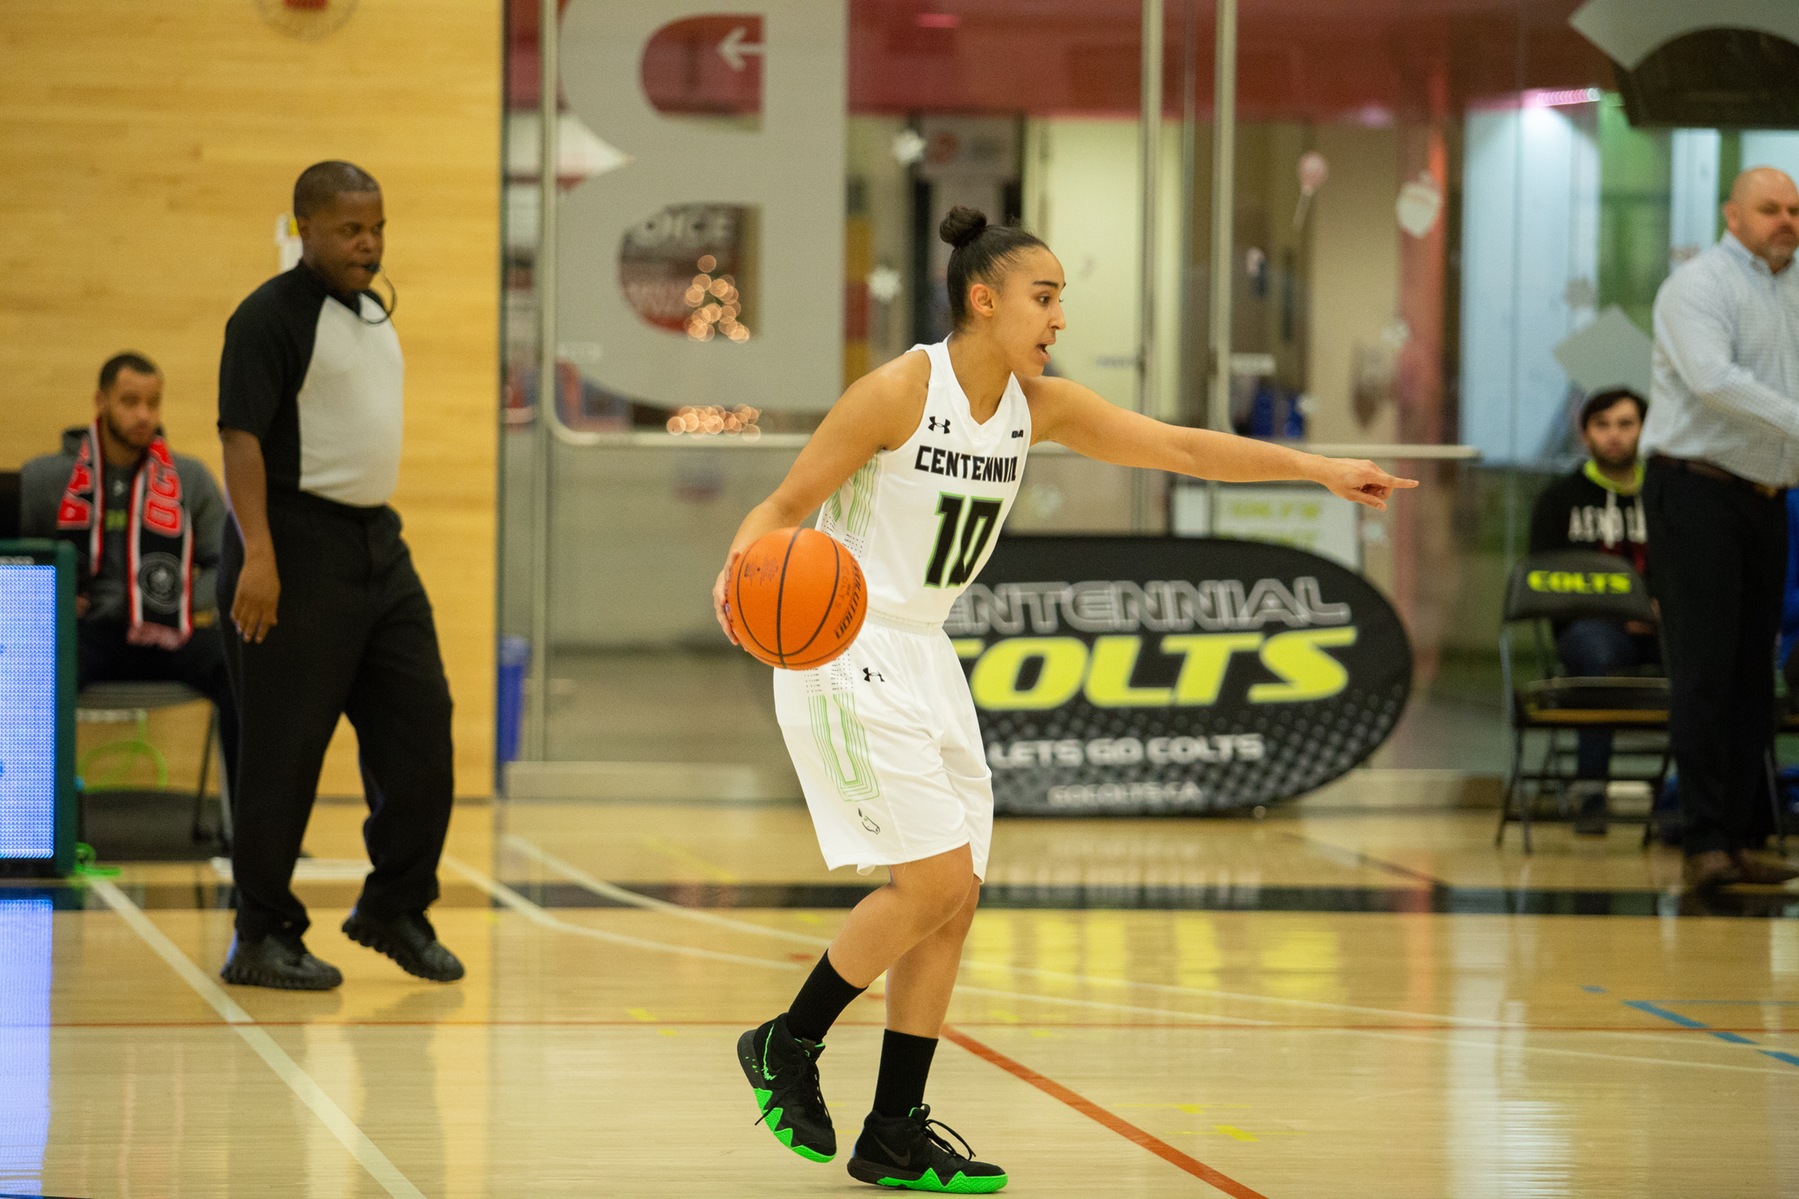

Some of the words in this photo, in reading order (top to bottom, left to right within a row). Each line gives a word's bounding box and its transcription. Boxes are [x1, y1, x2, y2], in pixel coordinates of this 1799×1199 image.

[923, 491, 1004, 589] 10
[942, 576, 1351, 636] NTENNIAL
[1527, 569, 1632, 595] COLTS
[952, 625, 1358, 711] OLTS
[988, 738, 1085, 769] LETS
[1086, 737, 1144, 766] GO
[1146, 732, 1265, 765] COLTS
